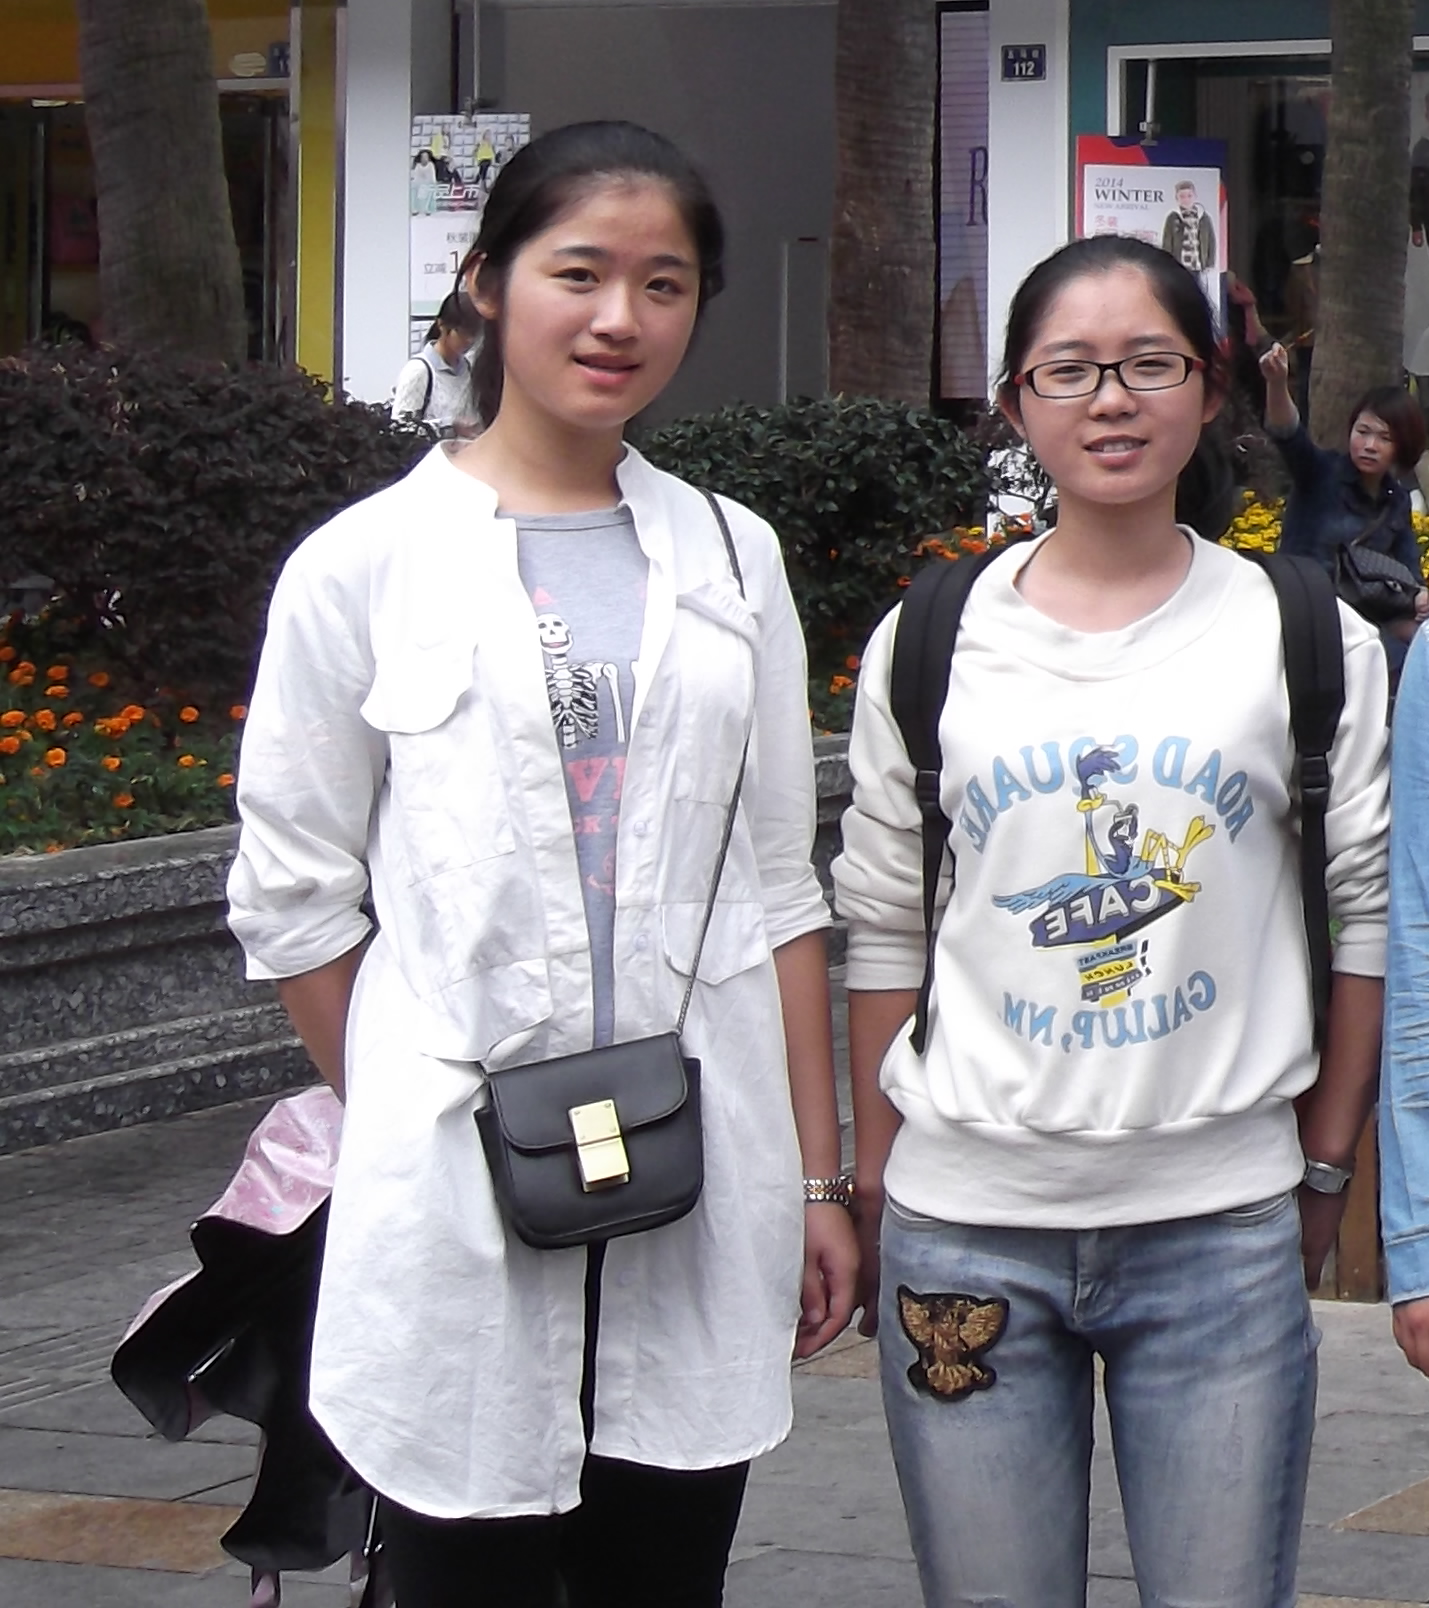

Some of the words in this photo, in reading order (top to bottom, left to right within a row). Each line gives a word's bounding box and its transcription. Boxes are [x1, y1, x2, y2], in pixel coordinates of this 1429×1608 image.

[1013, 61, 1035, 76] 112
[1095, 177, 1124, 188] 2014
[1095, 188, 1164, 203] WINTER
